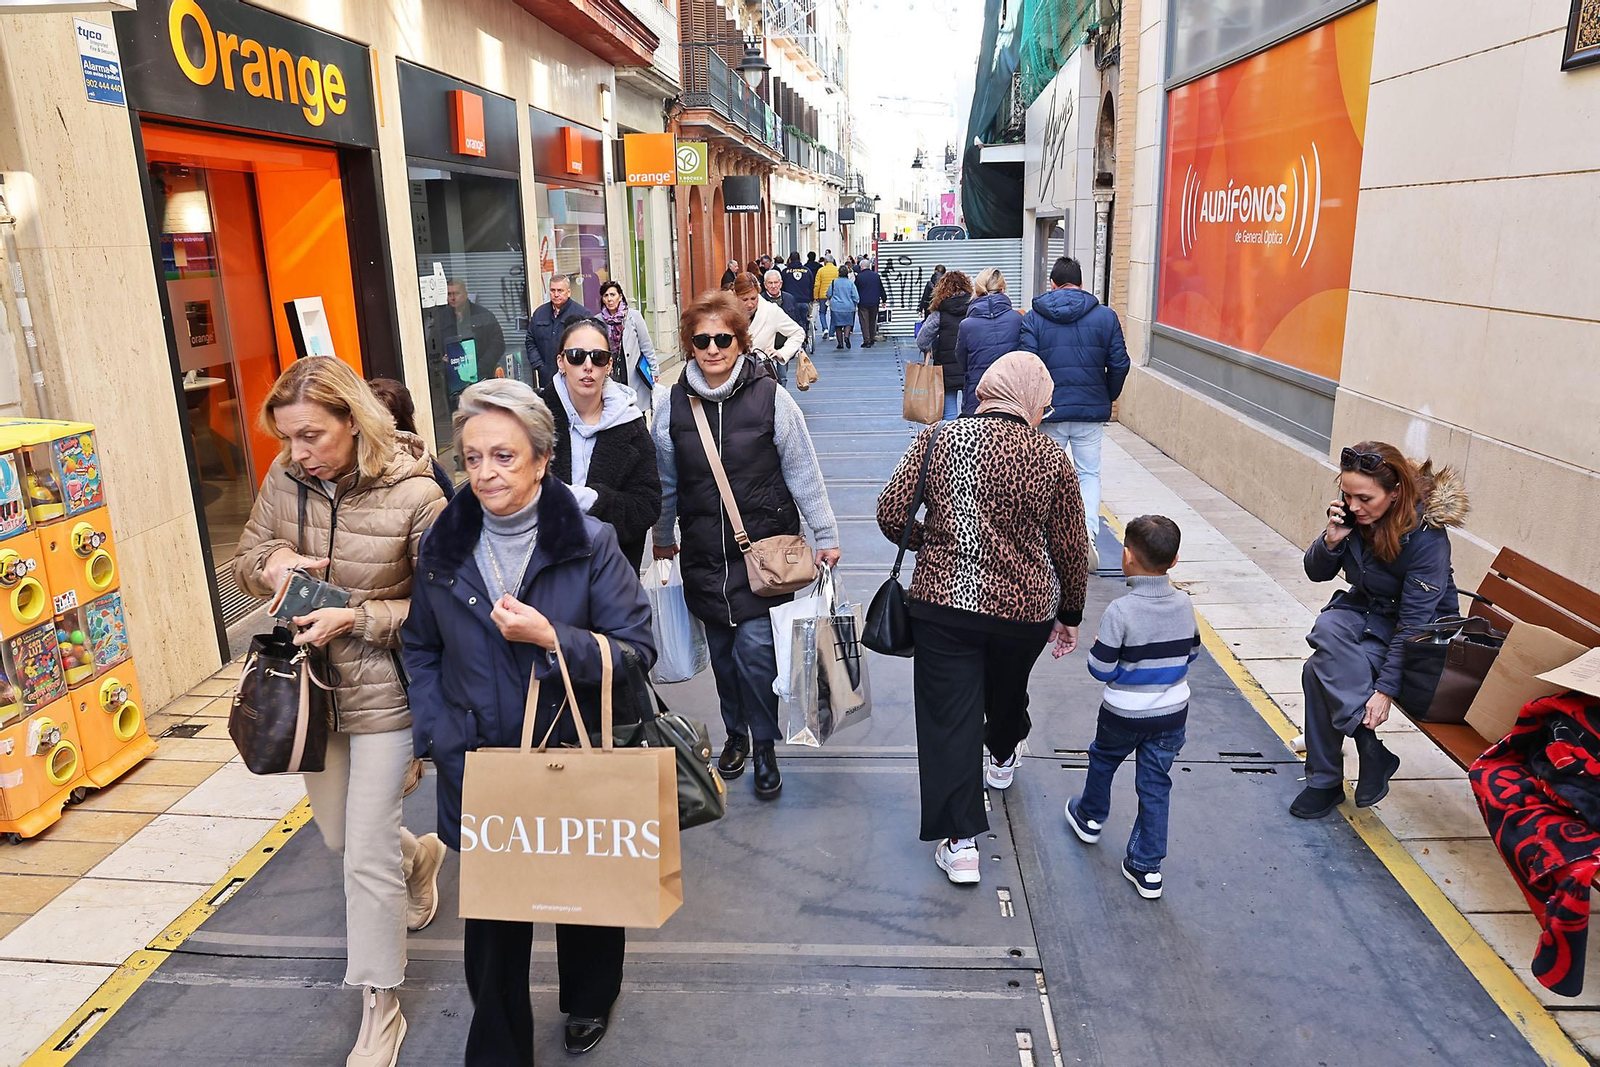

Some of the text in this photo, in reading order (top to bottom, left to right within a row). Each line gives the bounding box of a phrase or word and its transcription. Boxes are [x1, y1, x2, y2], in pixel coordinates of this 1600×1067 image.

[77, 26, 102, 40] tyco
[83, 59, 110, 74] Alarma
[168, 0, 347, 127] Orange
[85, 79, 122, 93] 902 444 440
[465, 138, 484, 154] orange
[628, 171, 671, 184] orange
[1200, 178, 1287, 223] AUDÍFONOS
[1235, 230, 1242, 243] de
[1242, 230, 1263, 244] General
[191, 333, 214, 344] orange
[460, 813, 660, 860] SCALPERS
